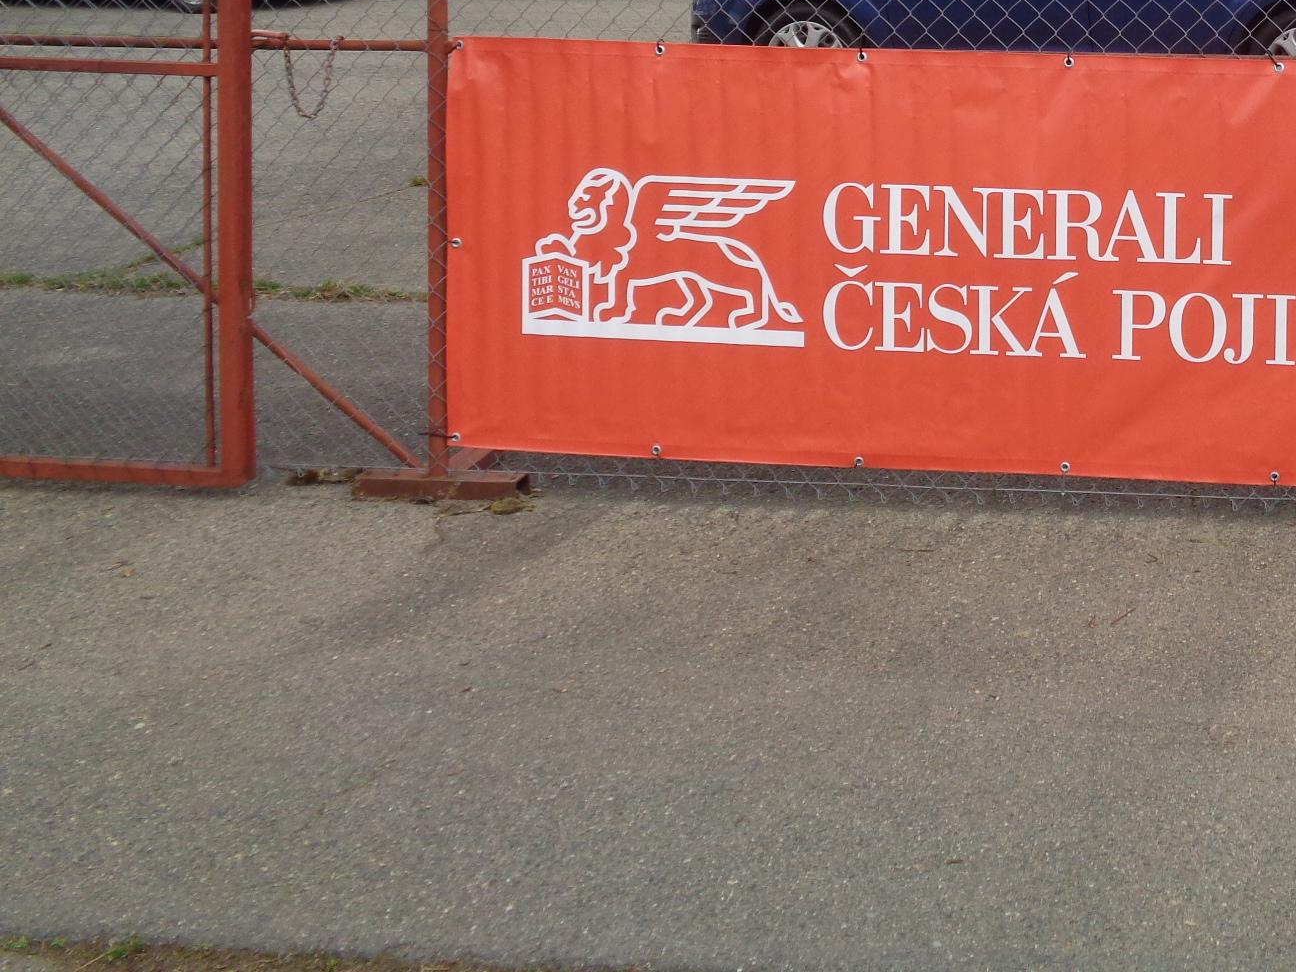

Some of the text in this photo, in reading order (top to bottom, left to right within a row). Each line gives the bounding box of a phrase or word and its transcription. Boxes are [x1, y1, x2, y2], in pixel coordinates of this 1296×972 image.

[822, 182, 1233, 266] GENERALI
[532, 265, 552, 276] PAX
[557, 264, 577, 278] VAN
[532, 275, 552, 286] TIBI
[557, 275, 579, 288] GELI
[532, 285, 553, 297] MAR
[557, 285, 576, 298] STA
[531, 294, 554, 306] CE E
[822, 263, 1087, 359] ČESKÁ
